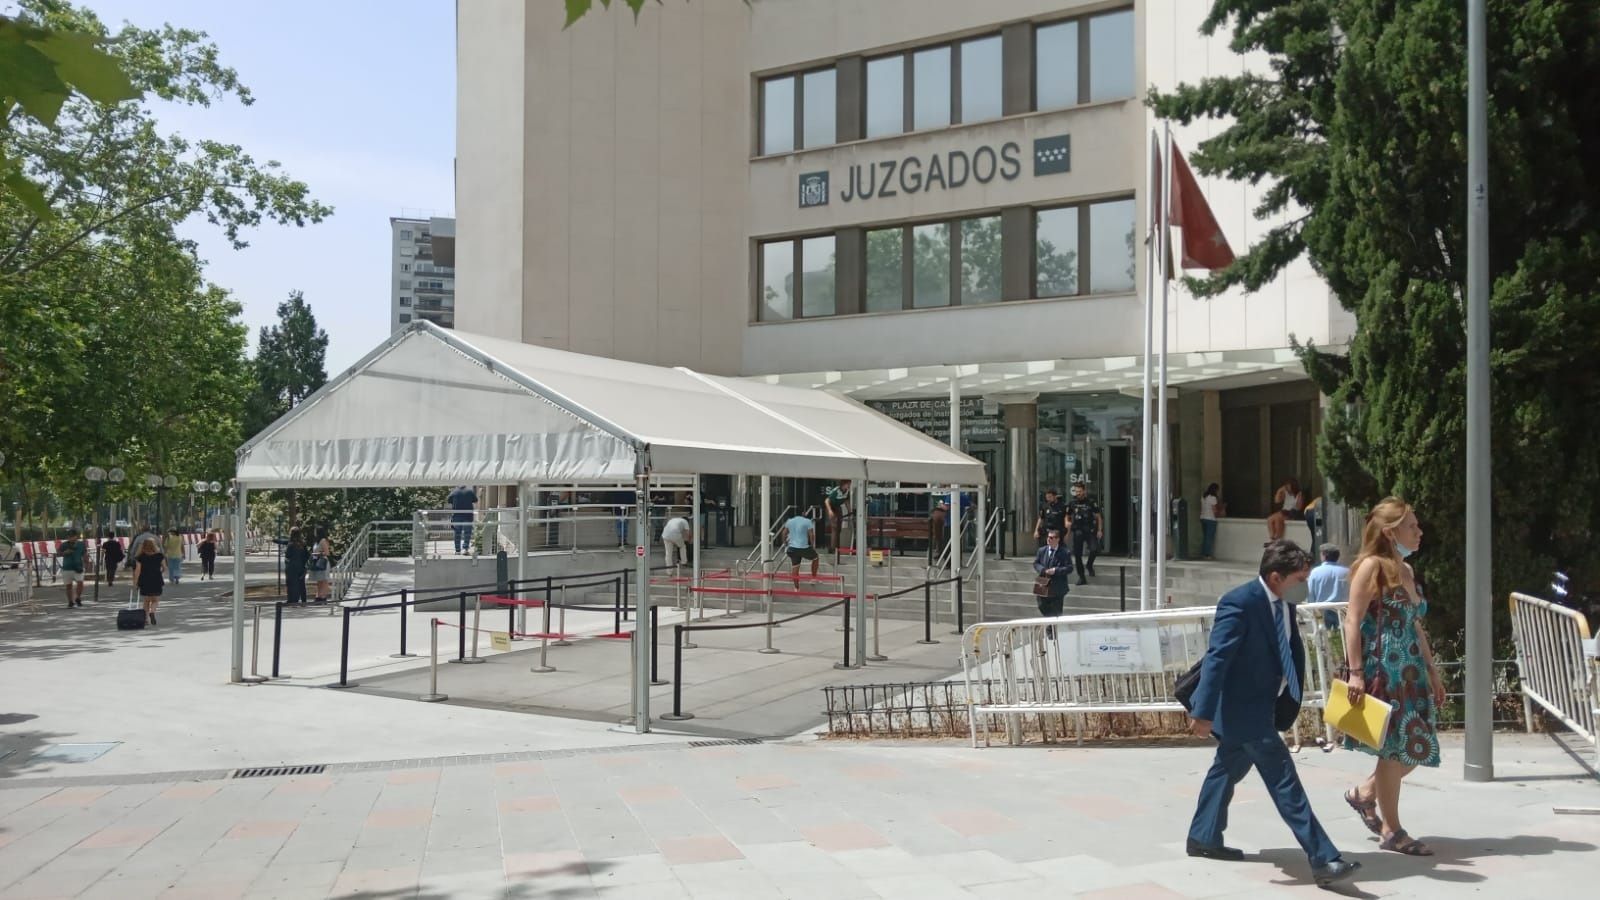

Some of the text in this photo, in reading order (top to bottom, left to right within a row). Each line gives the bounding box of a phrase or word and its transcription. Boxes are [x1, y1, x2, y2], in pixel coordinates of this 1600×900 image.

[840, 141, 1021, 203] JUZGADOS
[892, 401, 918, 409] PLAZA
[920, 401, 932, 409] DE
[972, 426, 998, 435] Madrid
[1069, 472, 1092, 484] SAL
